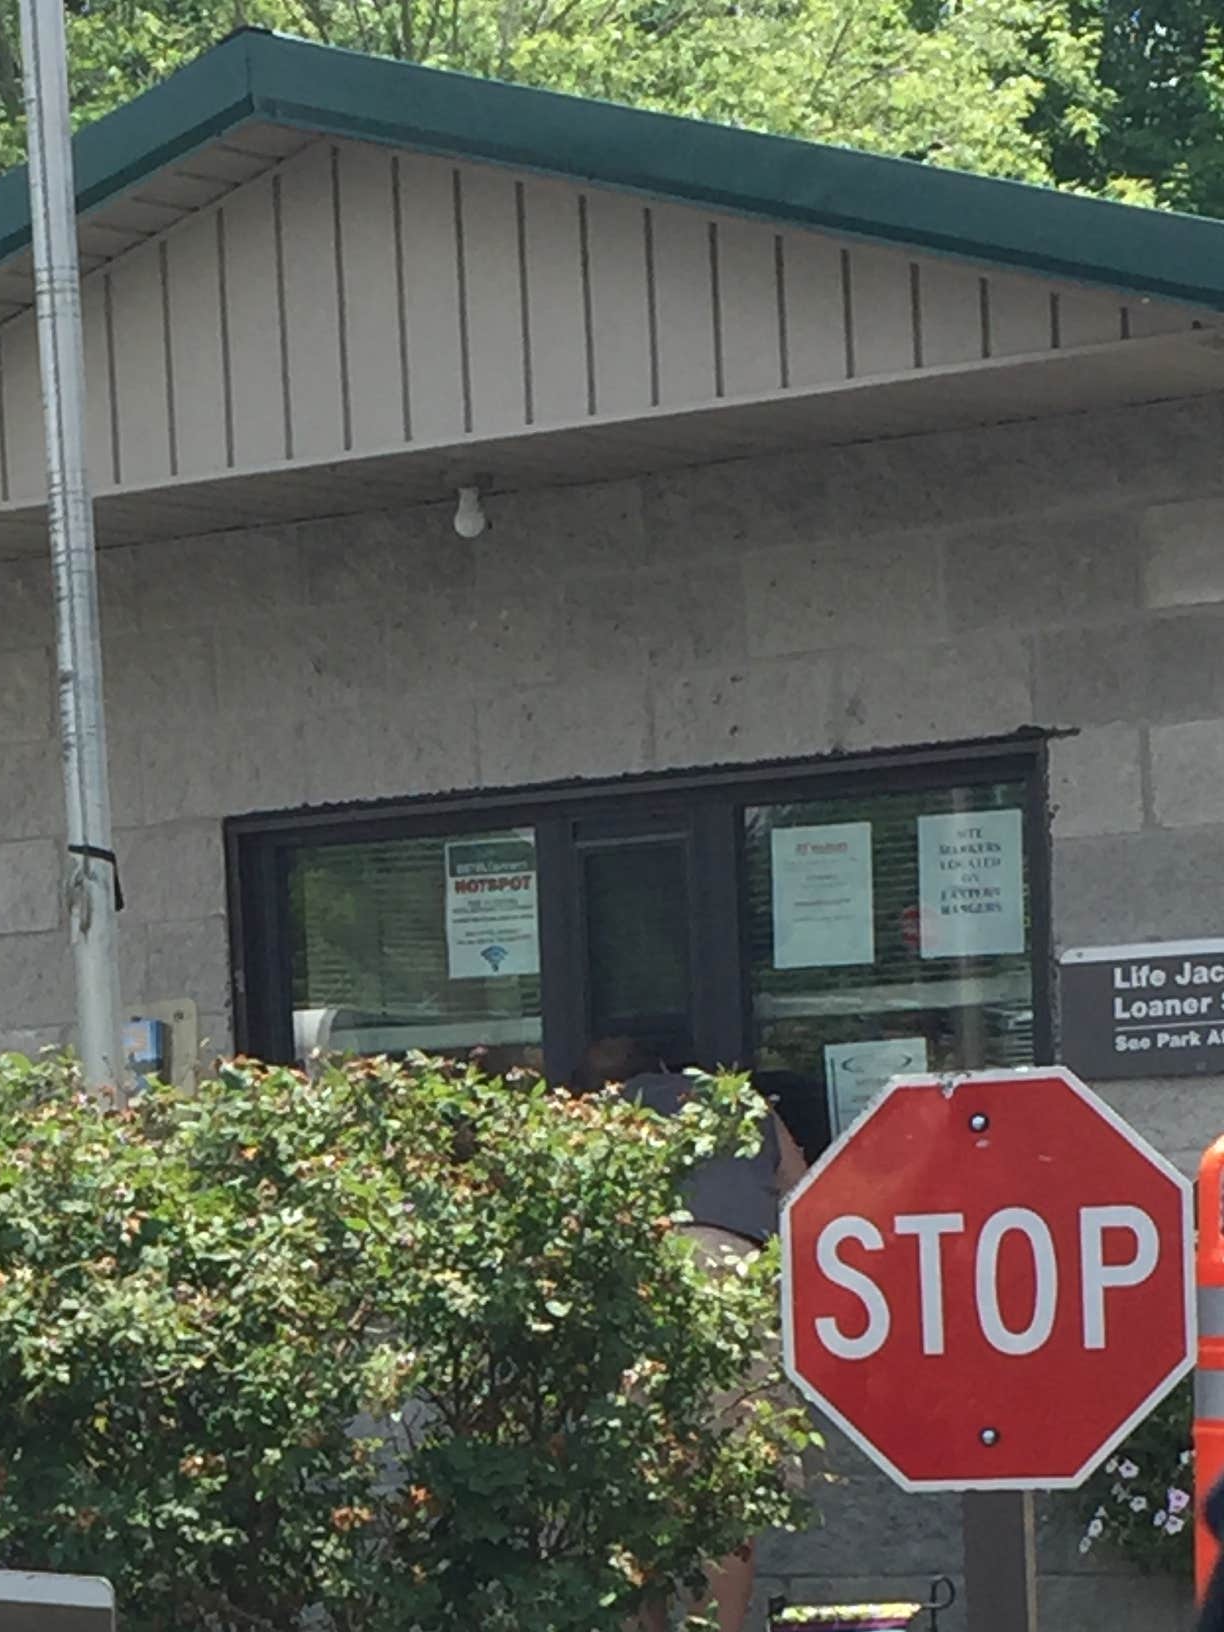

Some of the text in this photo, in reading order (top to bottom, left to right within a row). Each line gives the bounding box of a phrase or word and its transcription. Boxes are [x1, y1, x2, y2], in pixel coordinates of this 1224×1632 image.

[455, 876, 533, 894] HOTSPOT
[1113, 964, 1167, 989] Life
[1113, 996, 1213, 1020] Loaner
[1114, 1034, 1152, 1053] See
[1156, 1030, 1202, 1049] Park
[815, 1205, 1161, 1361] STOP
